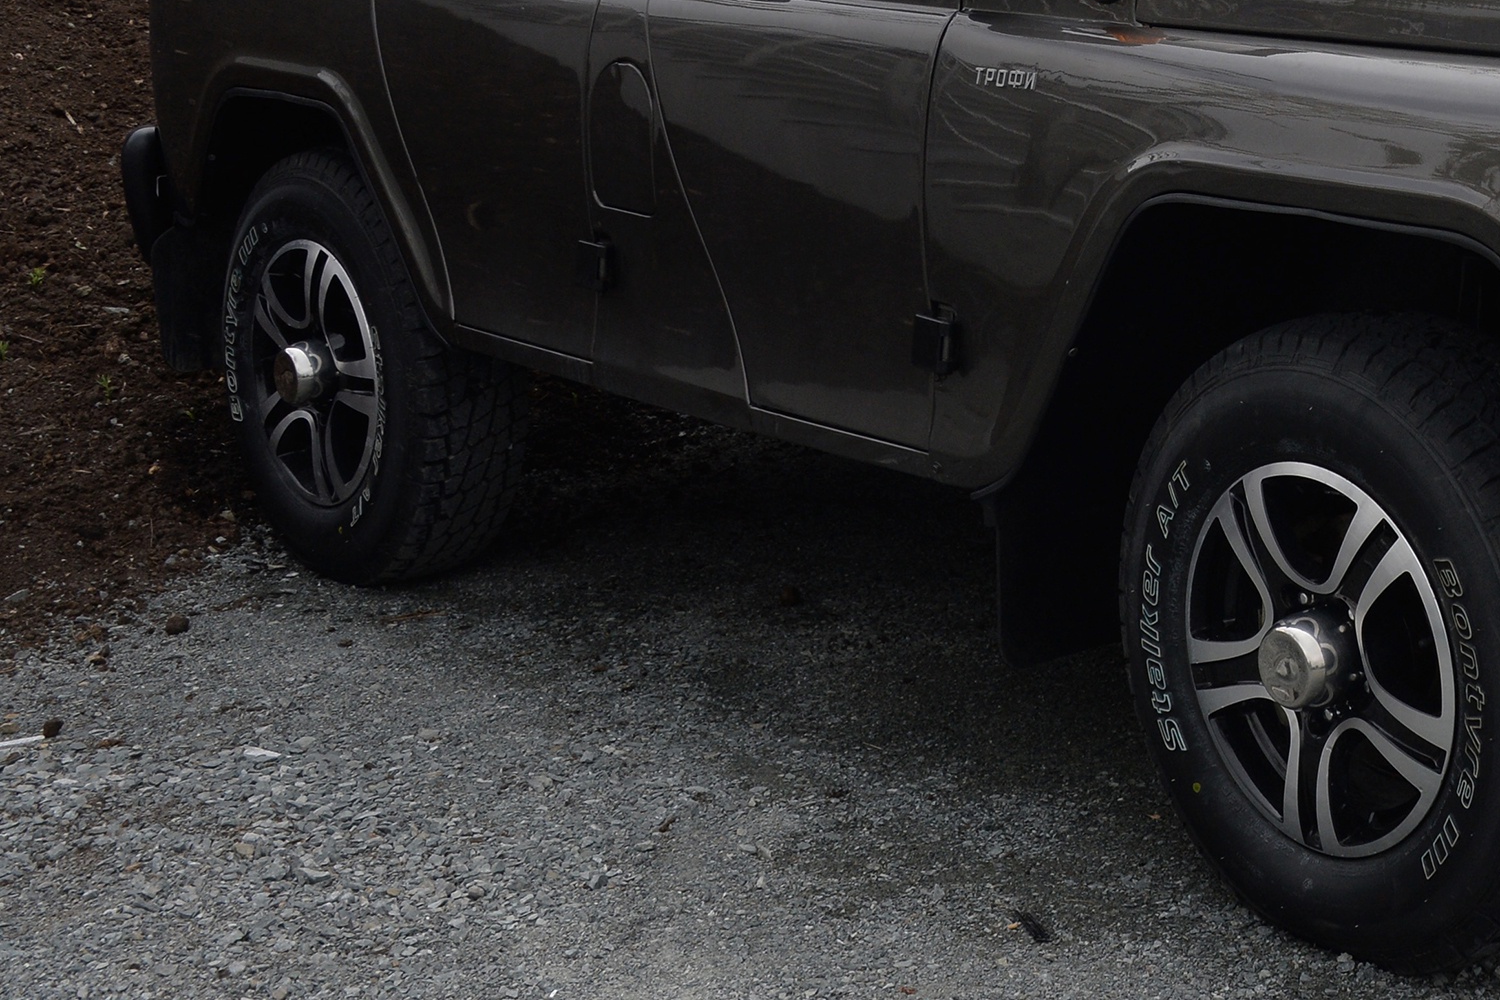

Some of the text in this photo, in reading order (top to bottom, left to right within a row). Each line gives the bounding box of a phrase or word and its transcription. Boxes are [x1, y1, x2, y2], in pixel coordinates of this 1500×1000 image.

[975, 66, 1038, 90] ТРОФИ
[1140, 459, 1191, 752] Stalker A/T
[1421, 557, 1486, 881] Bontyre III
